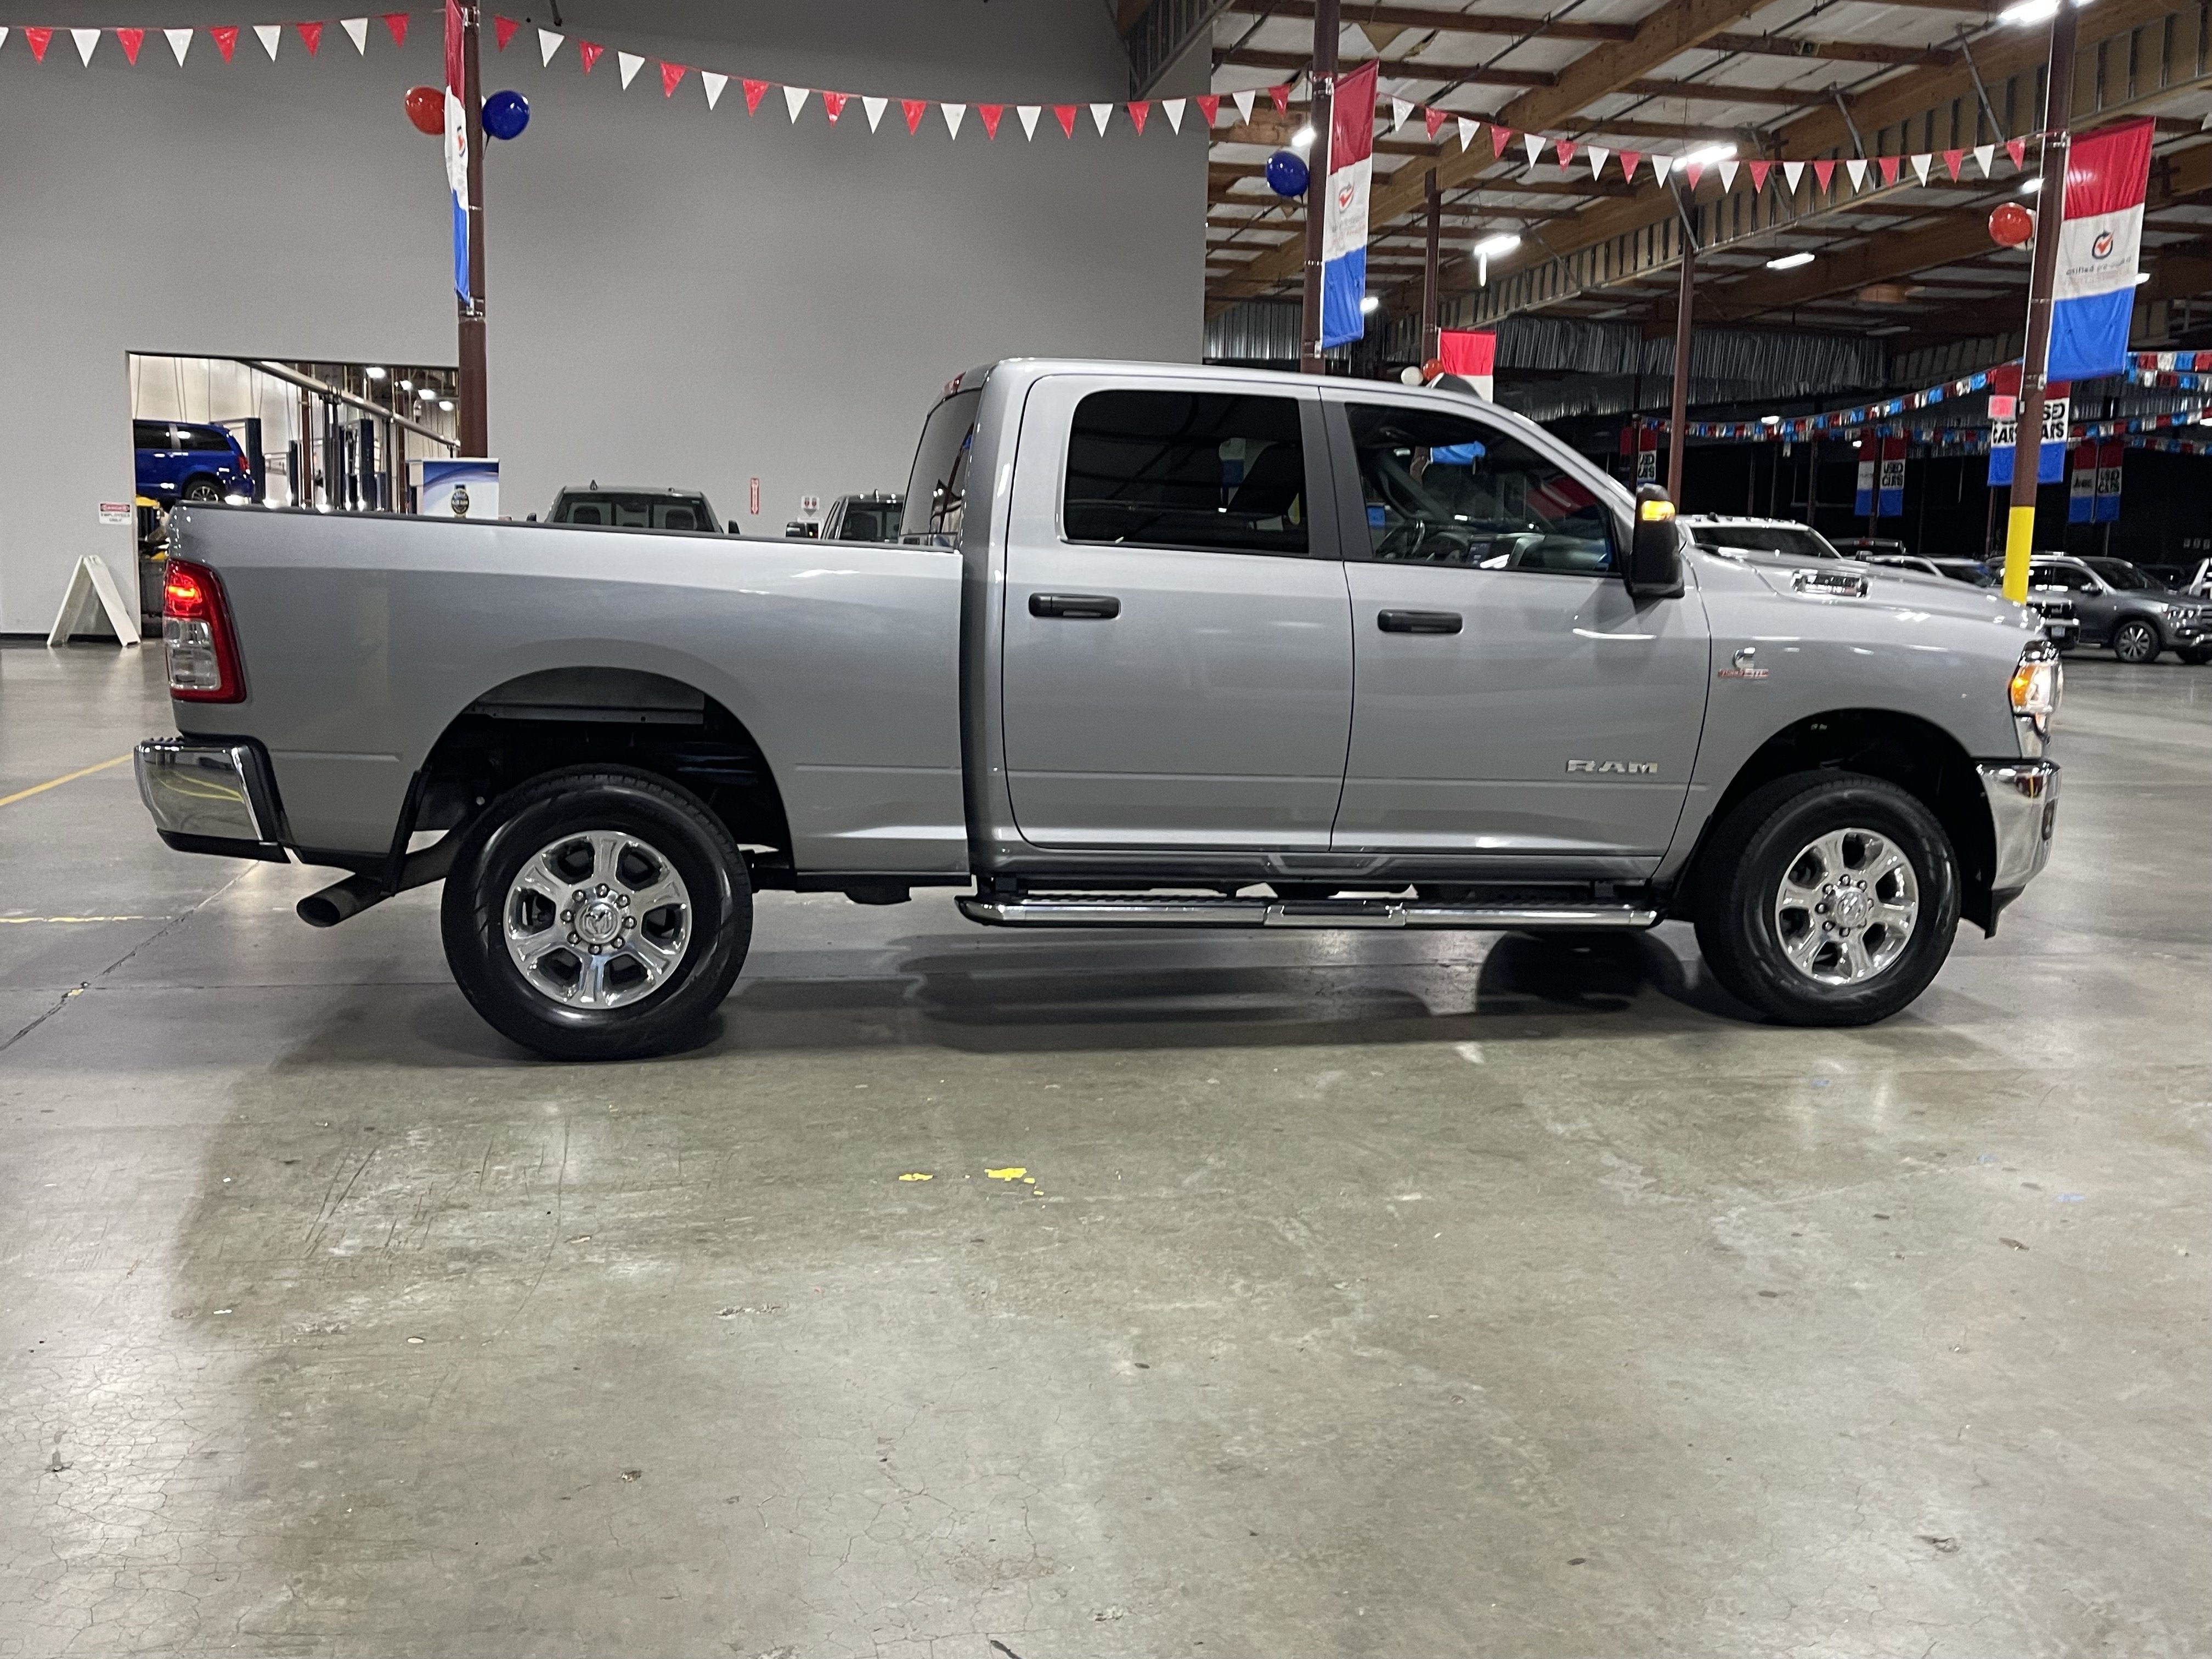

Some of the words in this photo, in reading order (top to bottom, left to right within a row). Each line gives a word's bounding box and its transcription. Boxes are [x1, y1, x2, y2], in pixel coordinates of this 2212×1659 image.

[2042, 403, 2065, 421] SED
[2042, 422, 2064, 439] ARS
[1566, 759, 1658, 774] RAM
